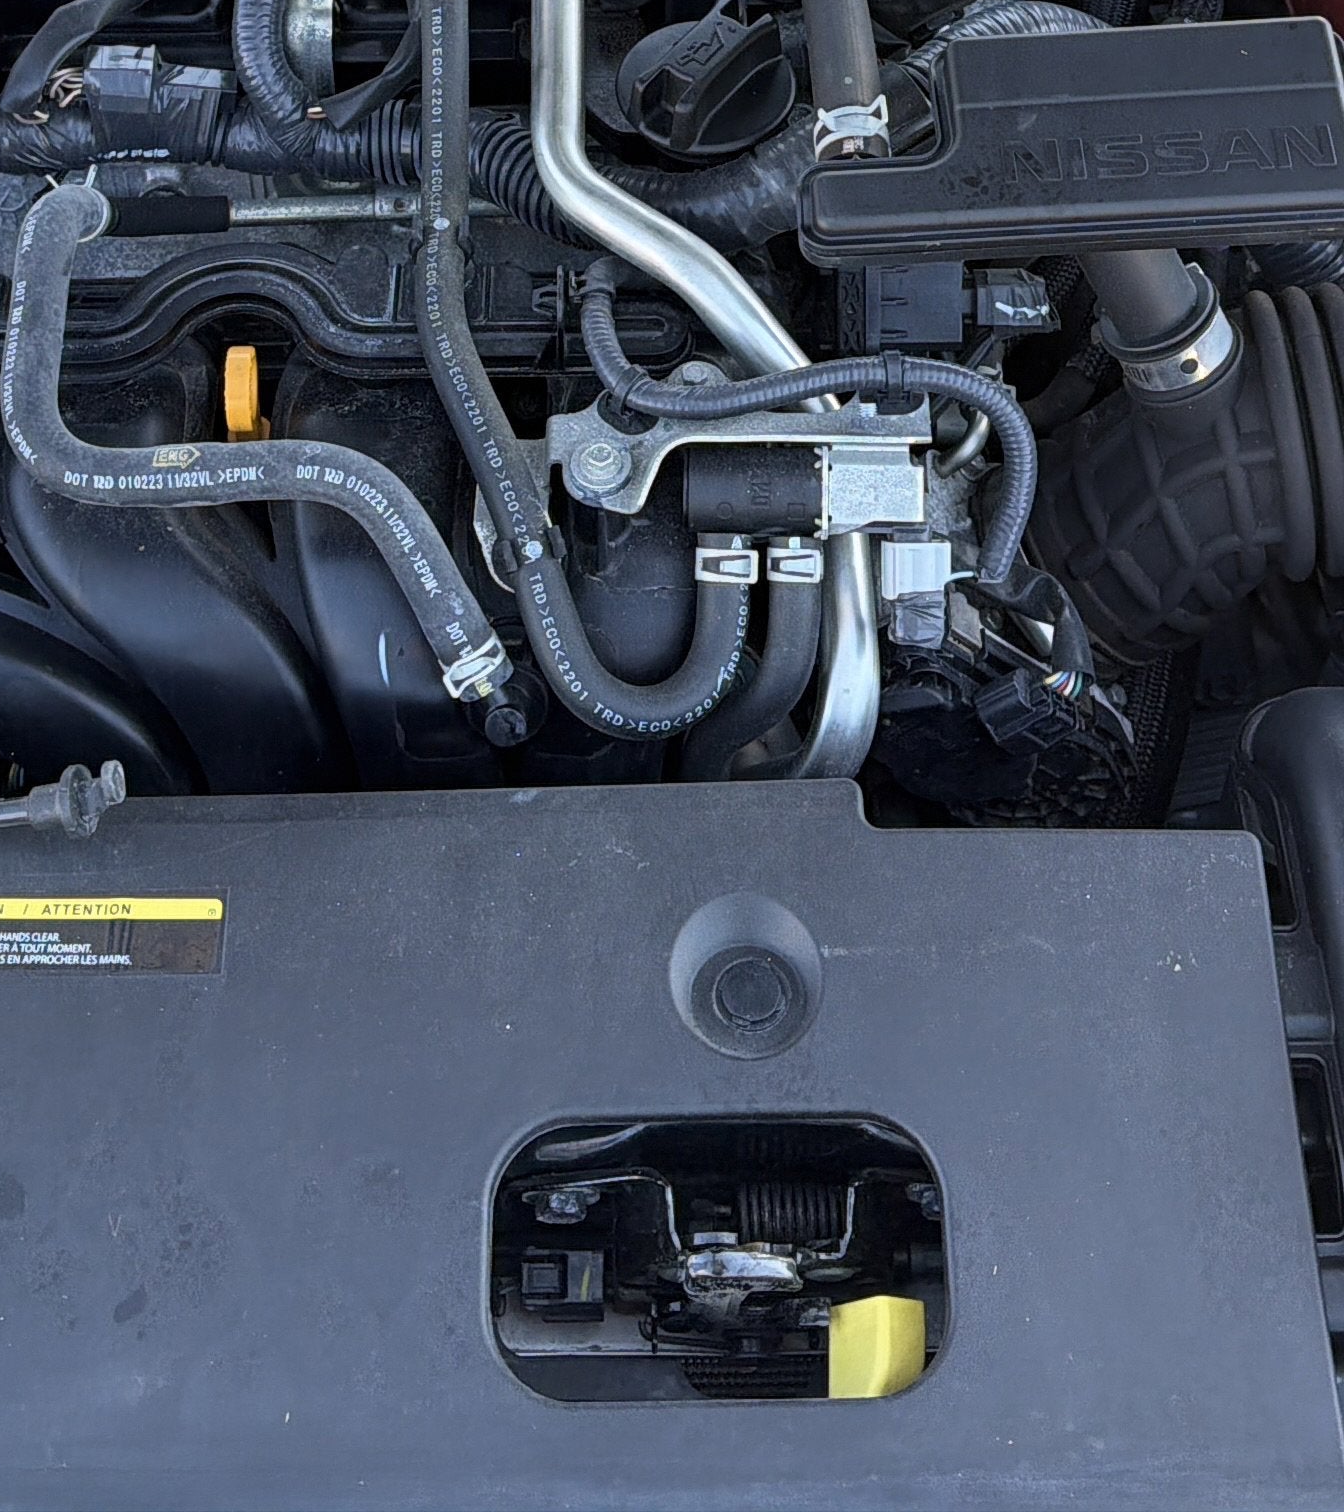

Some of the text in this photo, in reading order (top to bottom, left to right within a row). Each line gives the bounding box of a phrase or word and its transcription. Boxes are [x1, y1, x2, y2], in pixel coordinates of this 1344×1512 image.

[431, 6, 443, 124] TRD>ECO<2201
[1002, 123, 1338, 183] NISSAN
[430, 131, 443, 226] TRD>ECO<220
[14, 280, 27, 302] DOT
[435, 332, 488, 434] TRD>ECO<2201
[157, 448, 190, 463] ENG
[63, 470, 89, 488] DOT
[118, 475, 164, 489] 010223
[167, 471, 215, 489] 11/32VL
[217, 465, 265, 484] >EPDM<
[295, 464, 322, 481] DOT
[346, 475, 389, 514] 010223
[409, 550, 443, 599] >EPDM<
[445, 621, 469, 647] DOT
[528, 572, 589, 703] TRD>ECO<2201
[592, 689, 720, 733] TRD>ECO<2201
[23, 903, 29, 916] /
[41, 903, 132, 916] ATTENTION
[0, 932, 31, 942] HANDS
[31, 932, 62, 943] CLEAR.
[11, 941, 19, 953] À
[19, 943, 47, 953] TOUT
[46, 943, 93, 954] MOMENT.
[6, 954, 21, 964] EN
[21, 954, 80, 965] APPROCHER
[80, 955, 98, 965] LES
[98, 955, 133, 966] MAINS.
